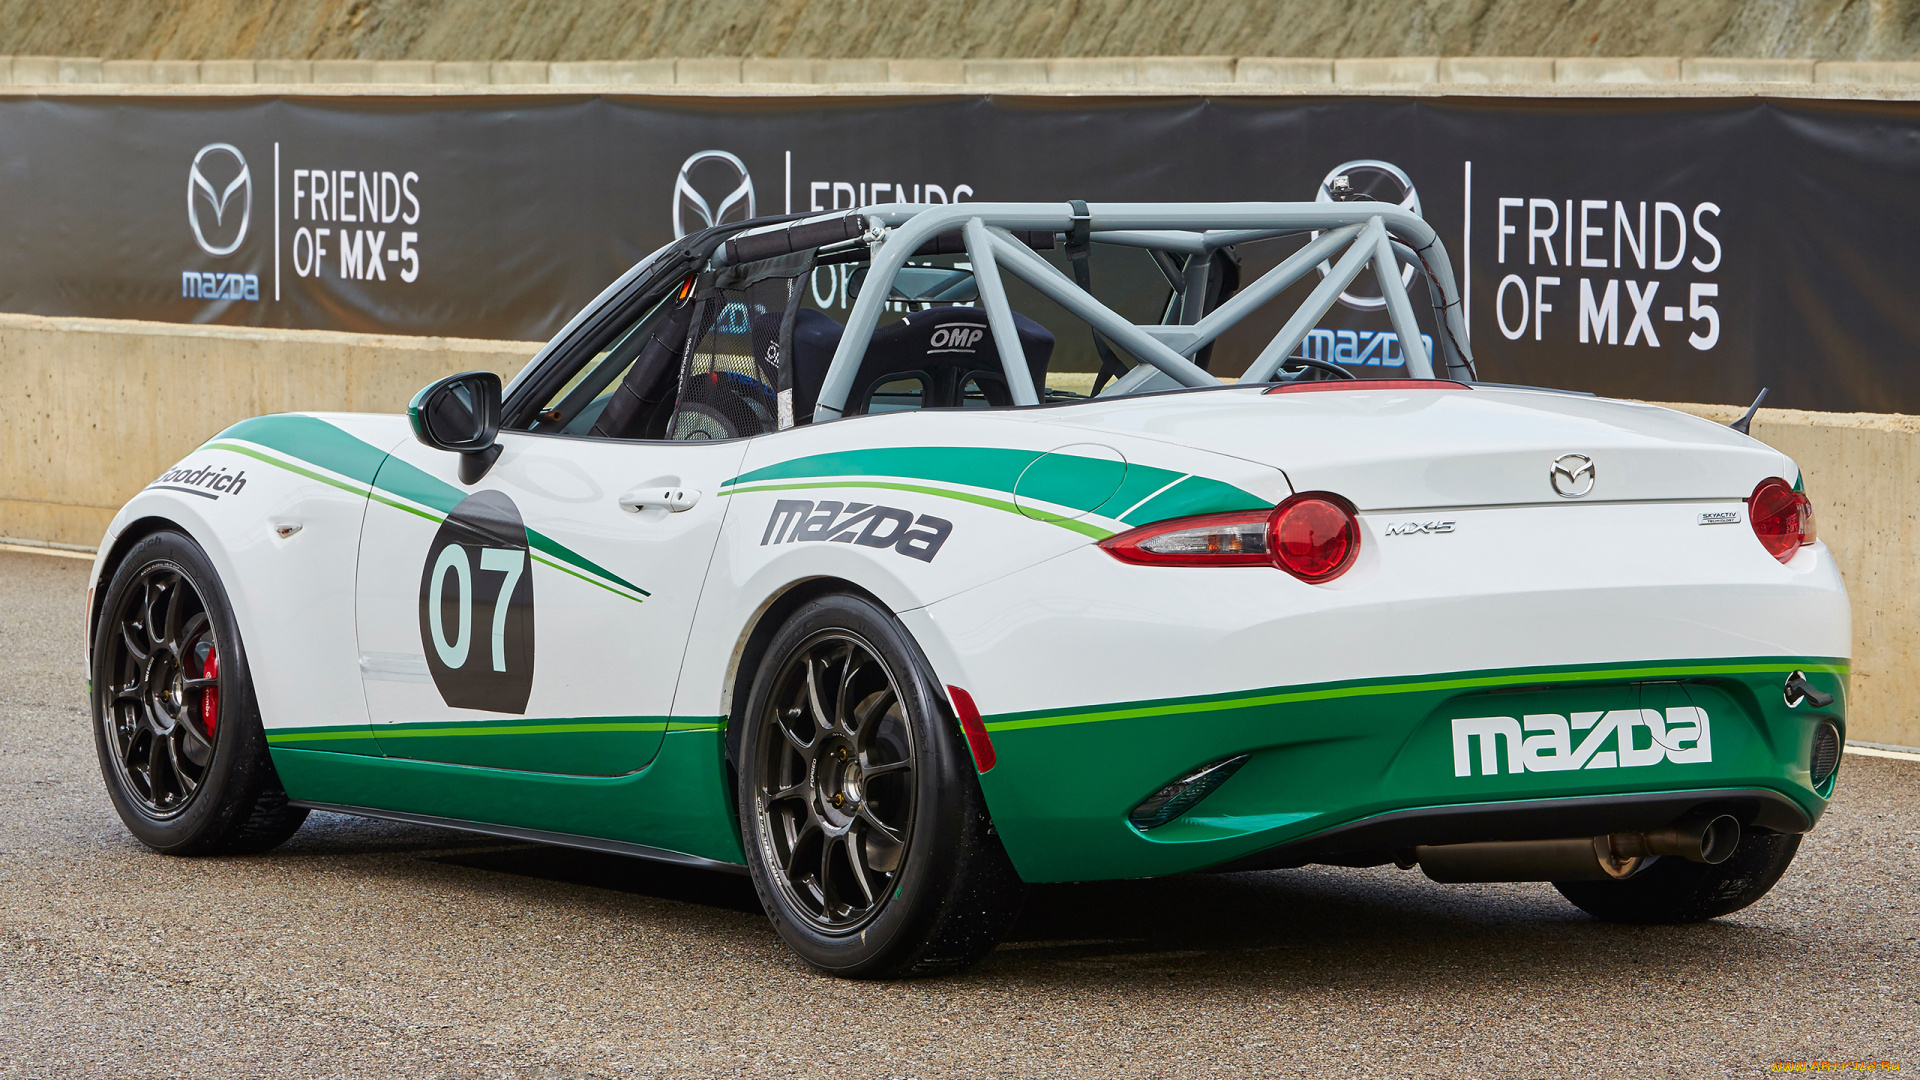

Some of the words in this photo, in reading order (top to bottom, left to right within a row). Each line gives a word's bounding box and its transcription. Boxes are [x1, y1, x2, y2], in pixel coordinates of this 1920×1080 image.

[293, 169, 420, 225] FRIENDS
[293, 227, 330, 278] OF
[340, 230, 420, 283] MX-5
[1497, 197, 1722, 273] FRIENDS
[930, 328, 984, 349] OMP
[1496, 274, 1560, 342] OF
[1579, 277, 1721, 351] MX-5
[1385, 520, 1456, 536] MX-5
[429, 544, 525, 672] 07
